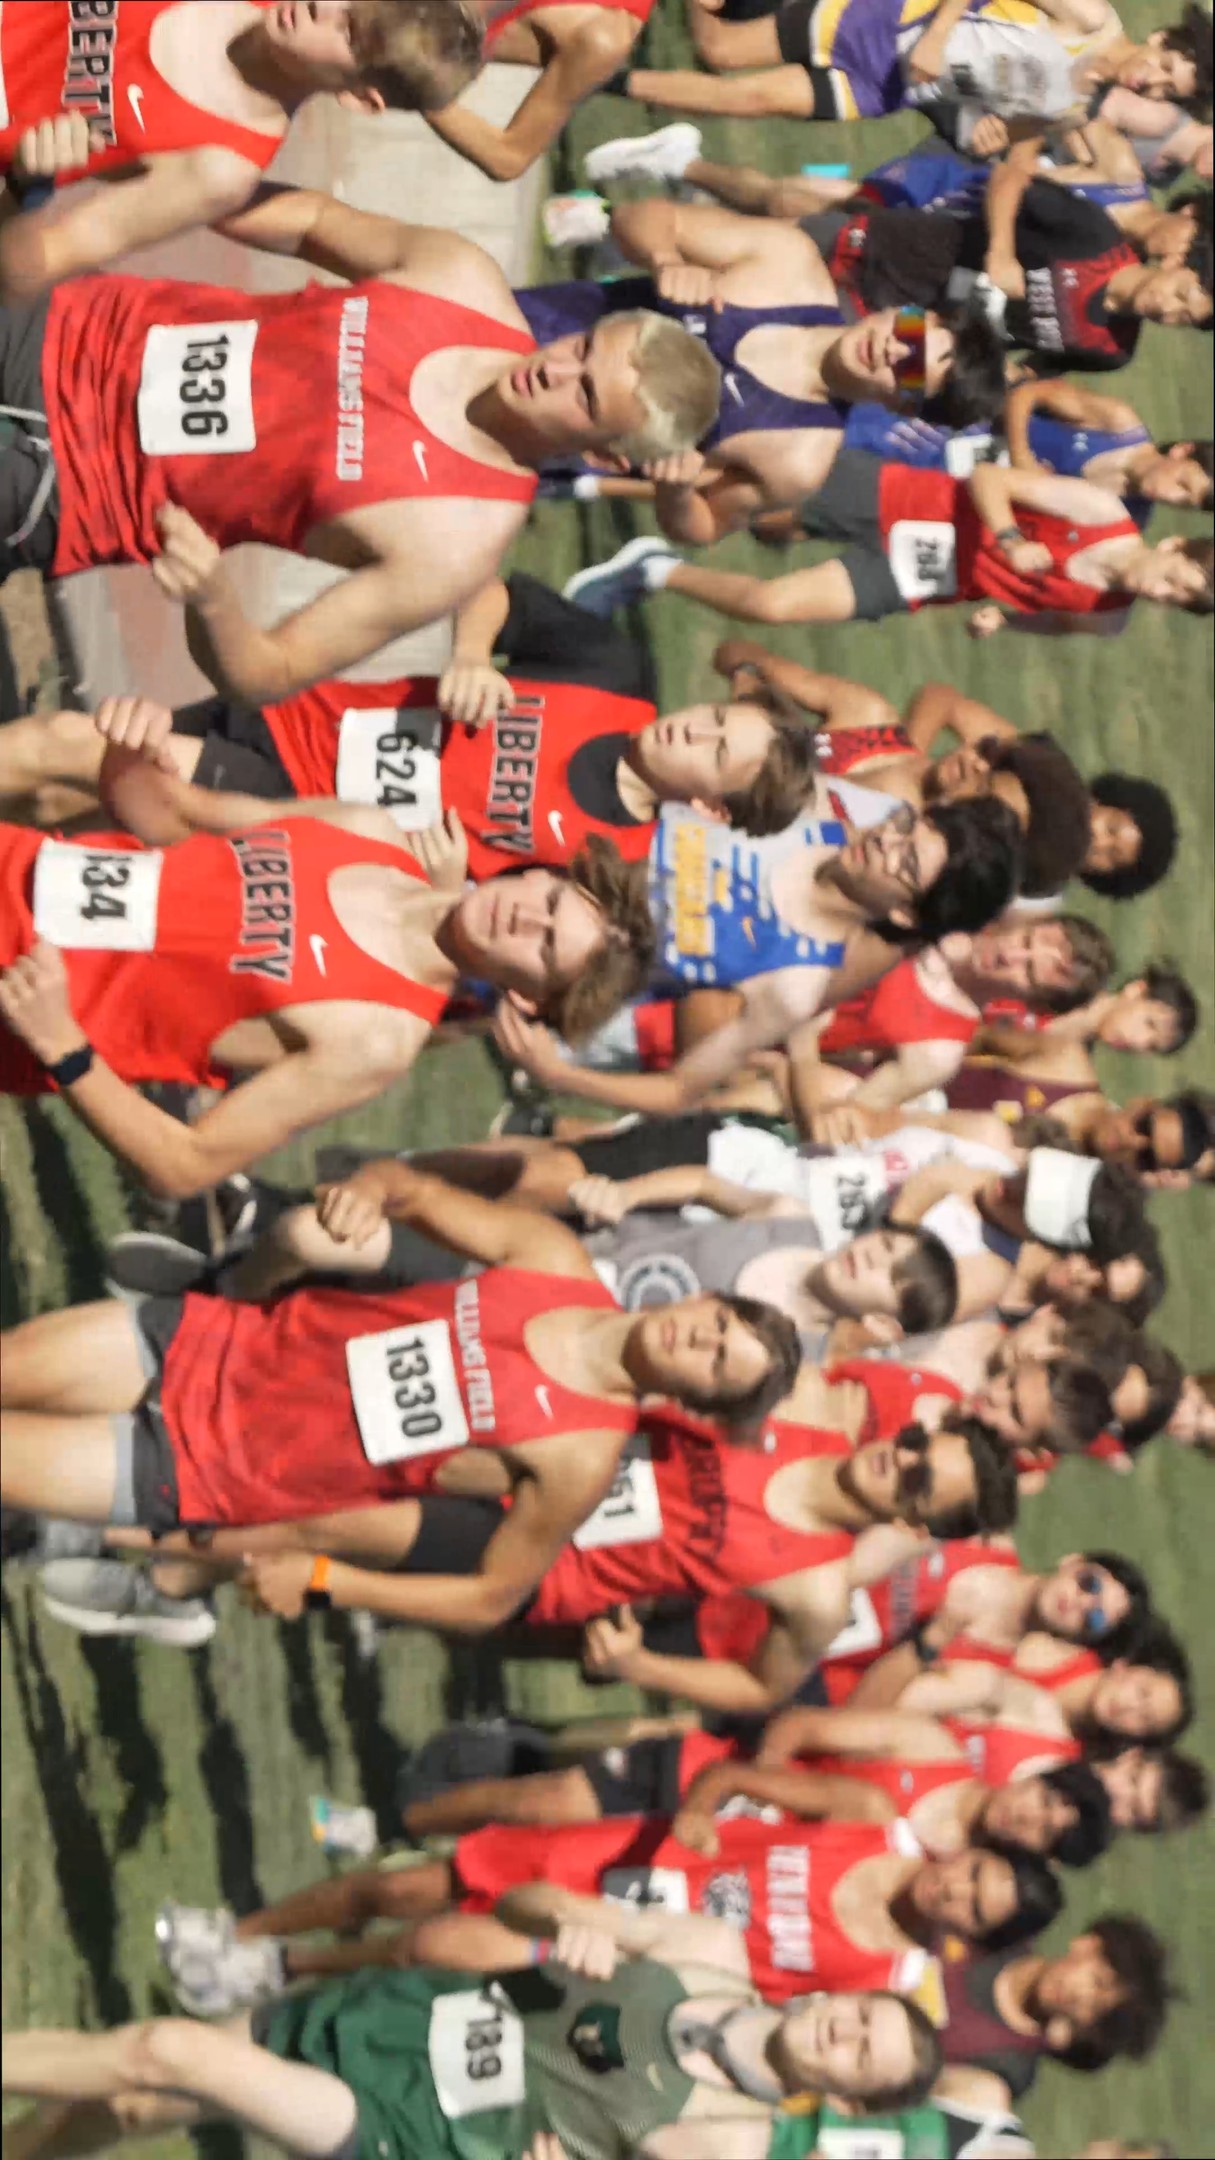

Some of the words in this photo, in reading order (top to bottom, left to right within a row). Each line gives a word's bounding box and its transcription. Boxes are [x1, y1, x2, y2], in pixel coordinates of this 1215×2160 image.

[179, 334, 231, 437] 1336
[375, 732, 419, 807] 624
[228, 830, 296, 986] LIBERTY
[386, 1337, 443, 1439] 1330
